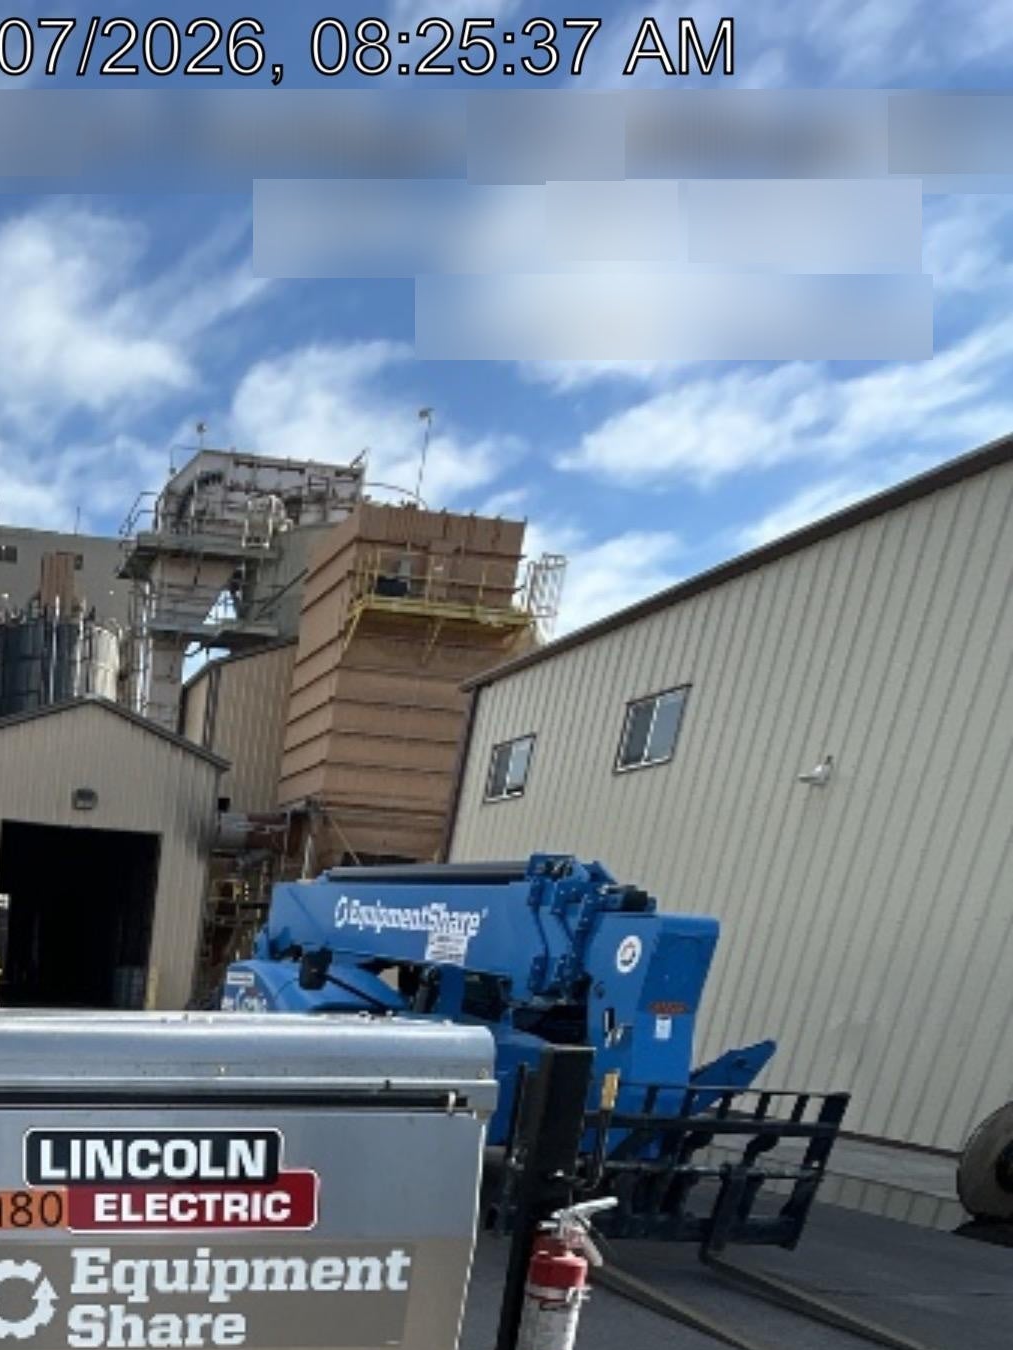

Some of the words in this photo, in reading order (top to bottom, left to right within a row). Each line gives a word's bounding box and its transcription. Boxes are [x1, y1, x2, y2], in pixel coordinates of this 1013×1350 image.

[348, 899, 481, 938] EquipmentShare
[40, 1139, 267, 1180] LINCOLN
[94, 1192, 291, 1223] ELECTRIC
[70, 1247, 411, 1303] Equipment
[67, 1304, 246, 1349] Share
